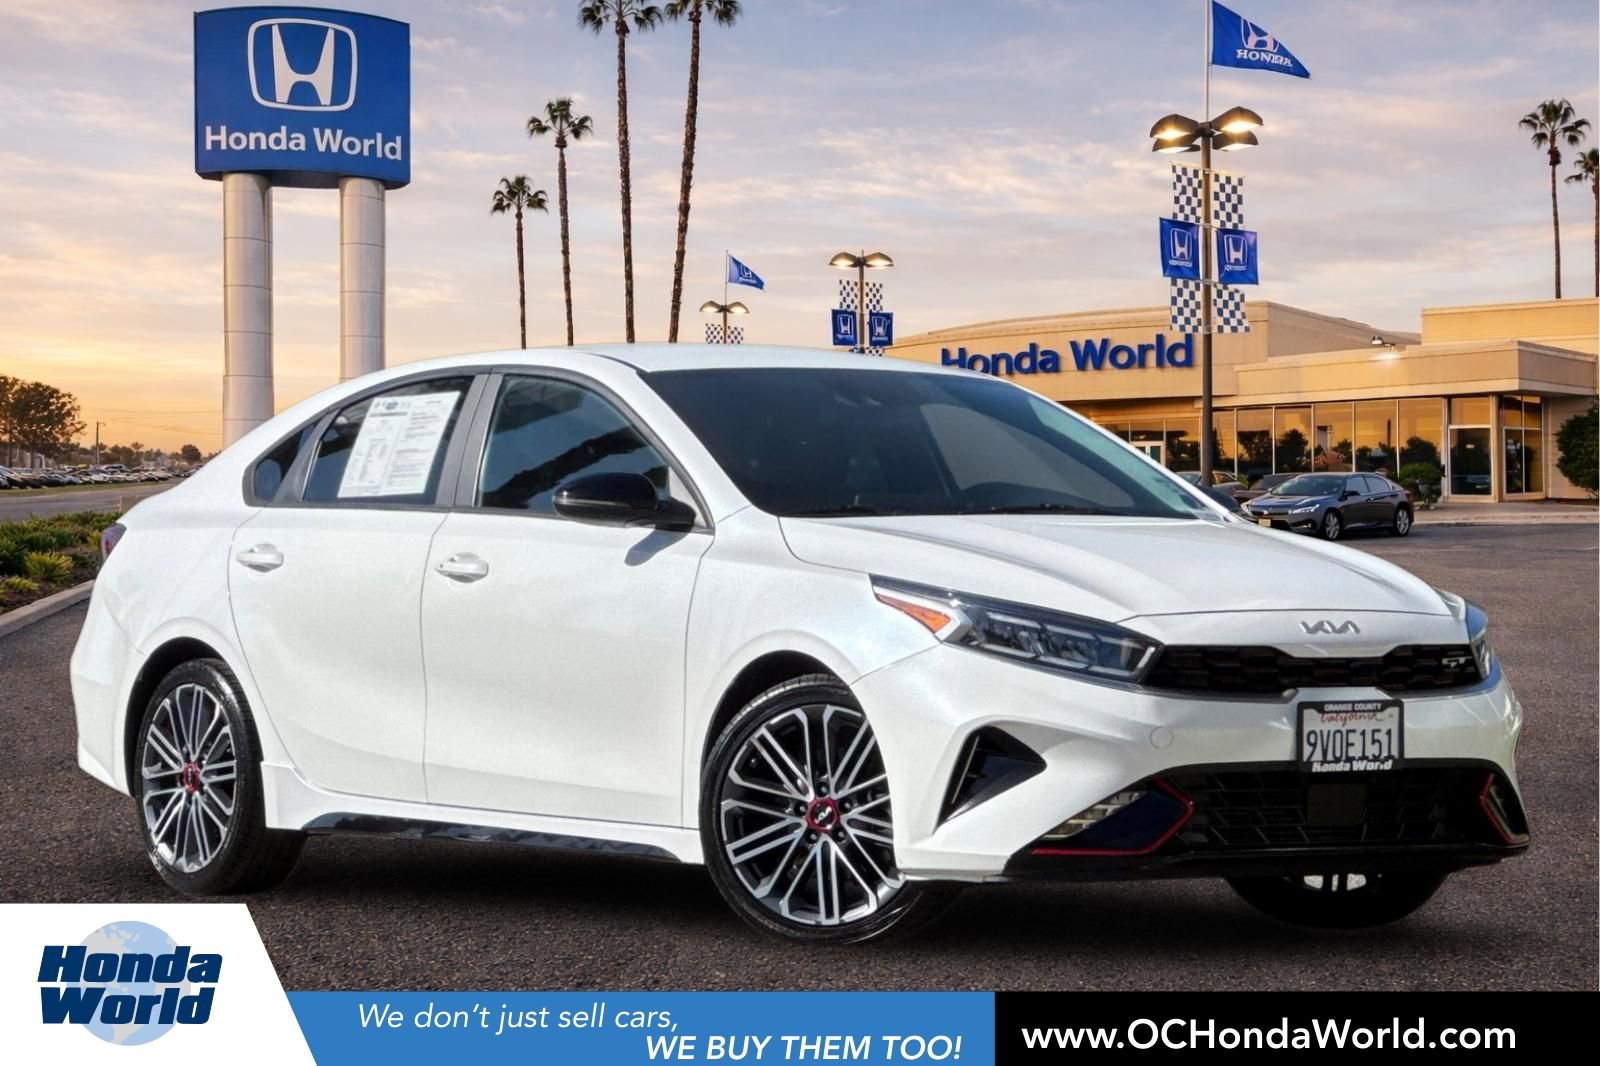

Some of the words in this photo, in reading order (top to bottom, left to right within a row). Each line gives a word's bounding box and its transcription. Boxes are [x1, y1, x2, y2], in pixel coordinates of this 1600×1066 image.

[1236, 49, 1293, 67] HONDA
[205, 125, 306, 151] Honda
[312, 127, 402, 160] World
[941, 342, 1062, 376] Honda
[1069, 333, 1194, 371] World
[1323, 703, 1353, 711] ORANGE
[1354, 703, 1382, 711] COUNTY
